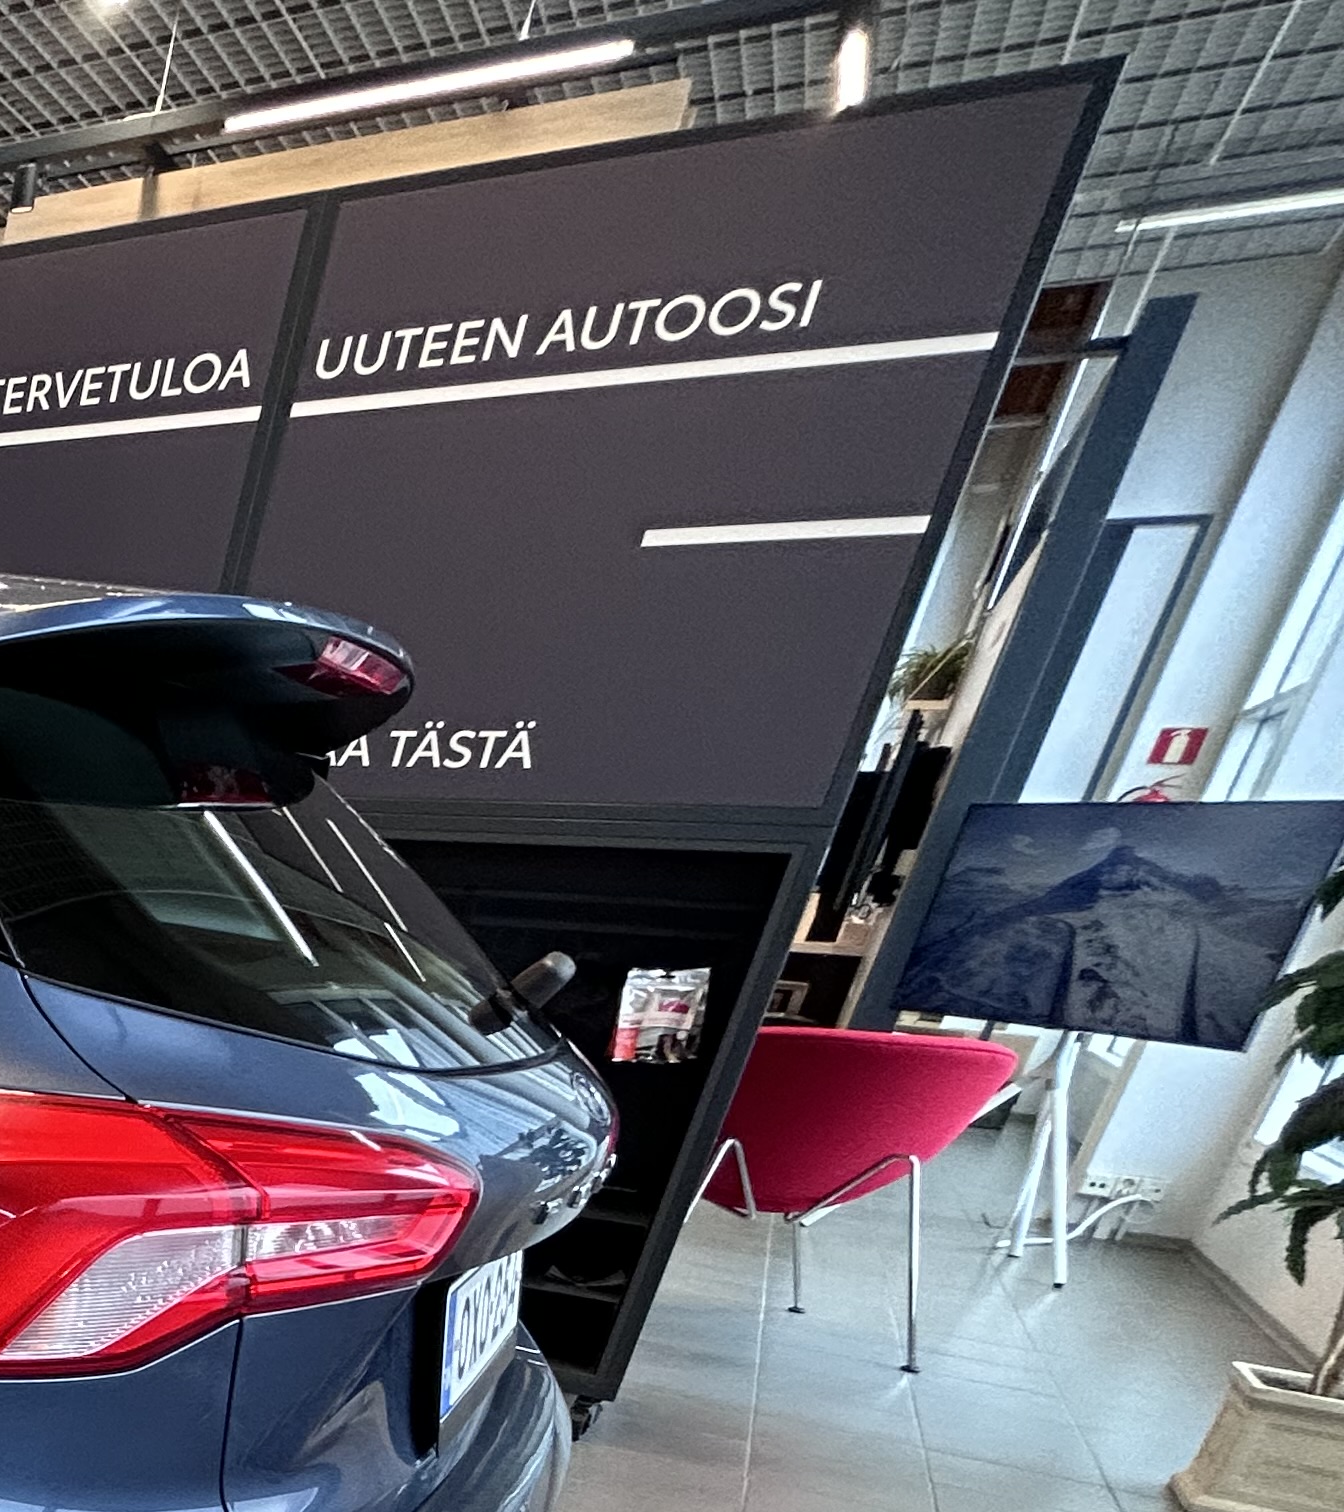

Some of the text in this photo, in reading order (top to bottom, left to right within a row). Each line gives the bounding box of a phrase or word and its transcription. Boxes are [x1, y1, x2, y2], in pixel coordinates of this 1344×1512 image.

[314, 314, 529, 380] UUTEEN
[536, 279, 823, 354] AUTOOSI
[390, 720, 536, 770] TÄSTÄ
